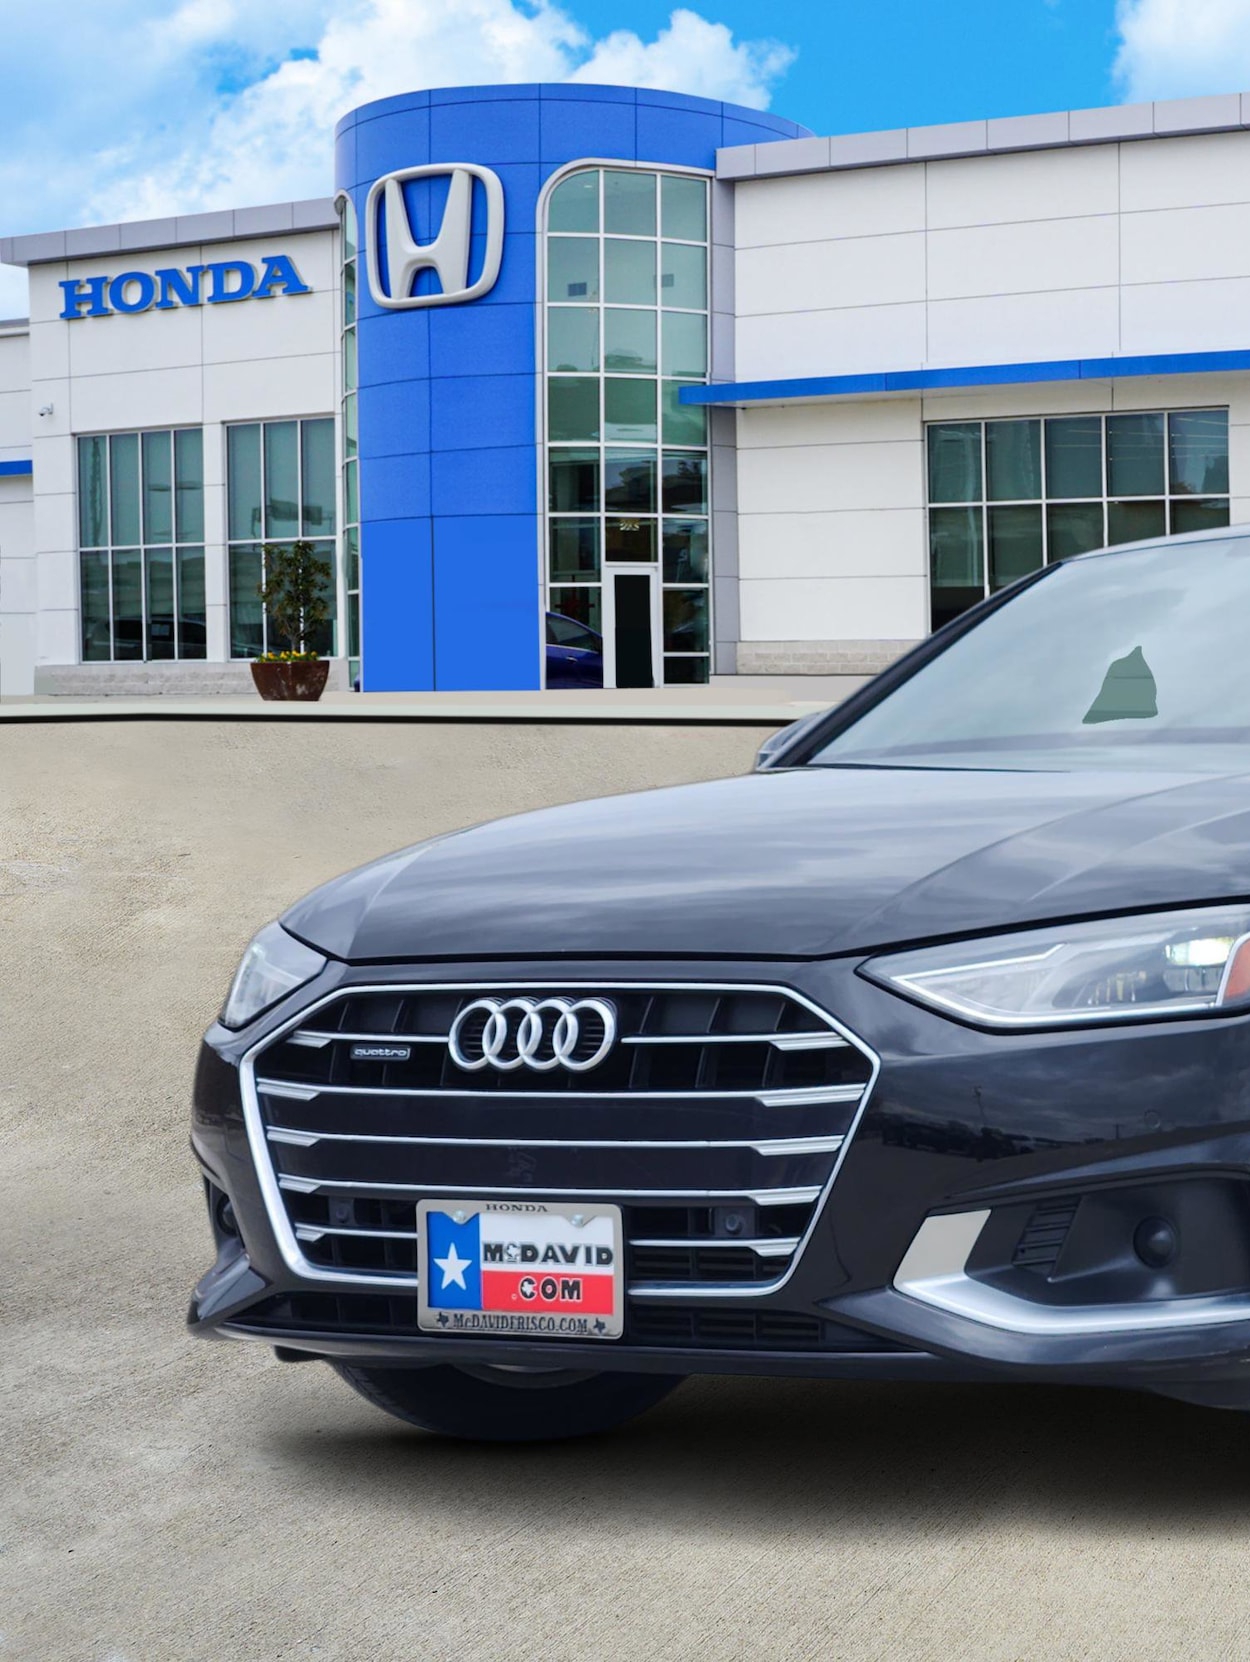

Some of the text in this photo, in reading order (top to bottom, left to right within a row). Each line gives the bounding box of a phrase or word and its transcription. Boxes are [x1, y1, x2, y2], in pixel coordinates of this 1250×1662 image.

[59, 254, 310, 320] HONDA
[354, 1047, 408, 1057] quattro
[485, 1203, 548, 1212] HONDA
[453, 1312, 588, 1333] McDAVIDFRISCO.COM
